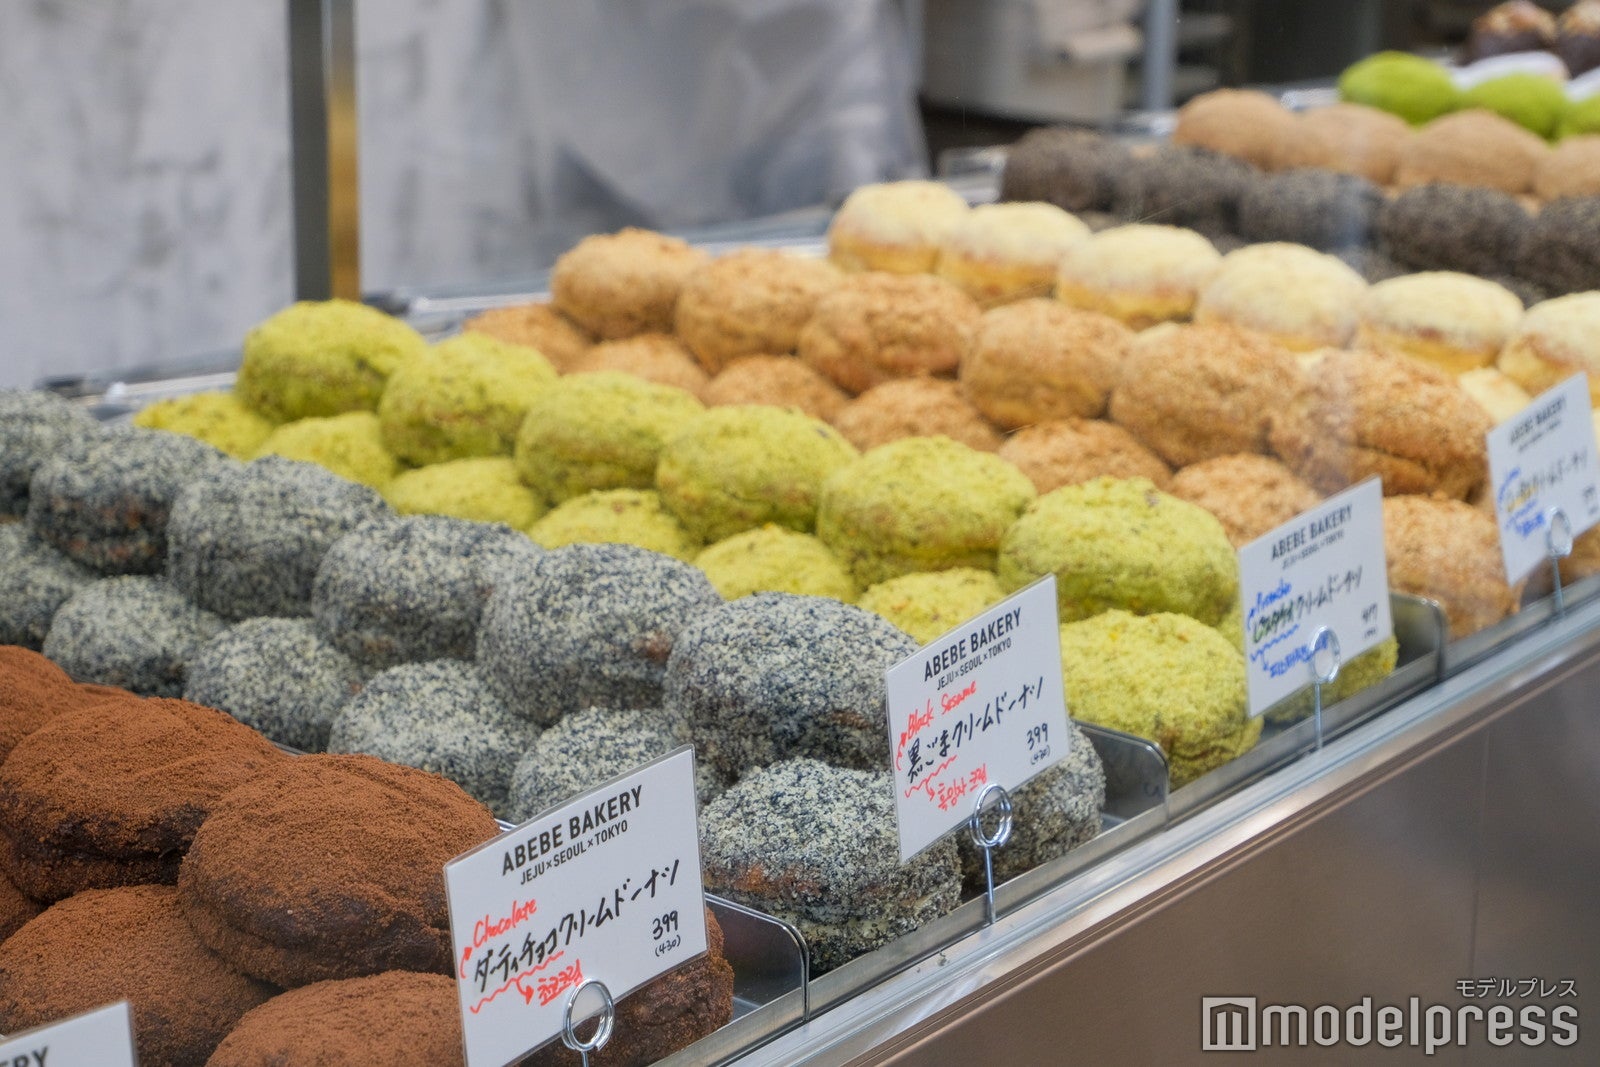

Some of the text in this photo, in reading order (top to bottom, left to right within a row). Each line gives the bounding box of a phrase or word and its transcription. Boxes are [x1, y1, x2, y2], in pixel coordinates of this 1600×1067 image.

[1310, 504, 1353, 539] BAKERY
[924, 607, 1022, 682] ABEBE BAKERY
[908, 698, 934, 741] Black
[908, 676, 1044, 783] 黒ごまクリームドーナツ
[1026, 722, 1048, 751] 399
[502, 785, 642, 876] ABEBE BAKERY
[473, 899, 538, 948] Chocolate
[652, 910, 679, 940] 399
[655, 934, 681, 957] (430)
